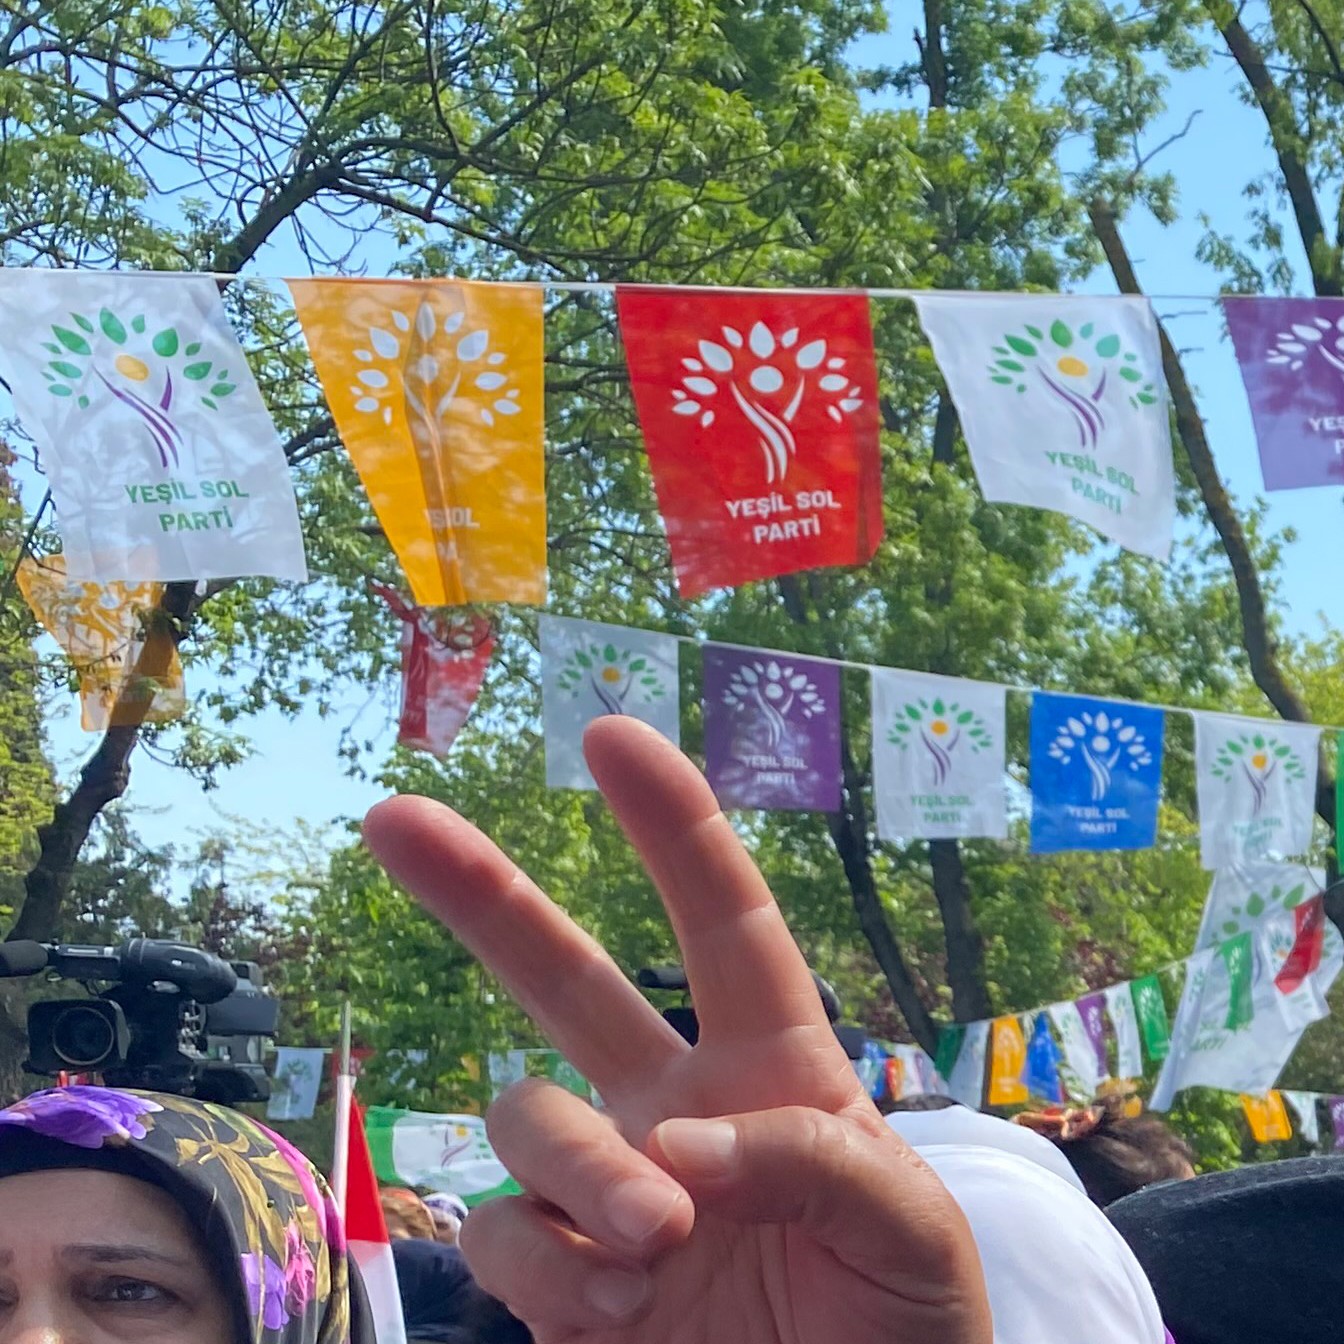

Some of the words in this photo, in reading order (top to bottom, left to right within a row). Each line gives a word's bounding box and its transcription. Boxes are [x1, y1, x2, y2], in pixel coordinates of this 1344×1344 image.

[1044, 451, 1103, 477] YEŞİL
[1105, 466, 1140, 496] SOL
[125, 478, 197, 504] YEŞİL
[199, 480, 249, 498] SOL
[725, 491, 792, 520] YEŞİL
[796, 490, 842, 510] SOL
[1071, 476, 1121, 515] PARTİ
[159, 506, 233, 532] PARTİ
[753, 513, 821, 544] PARTİ
